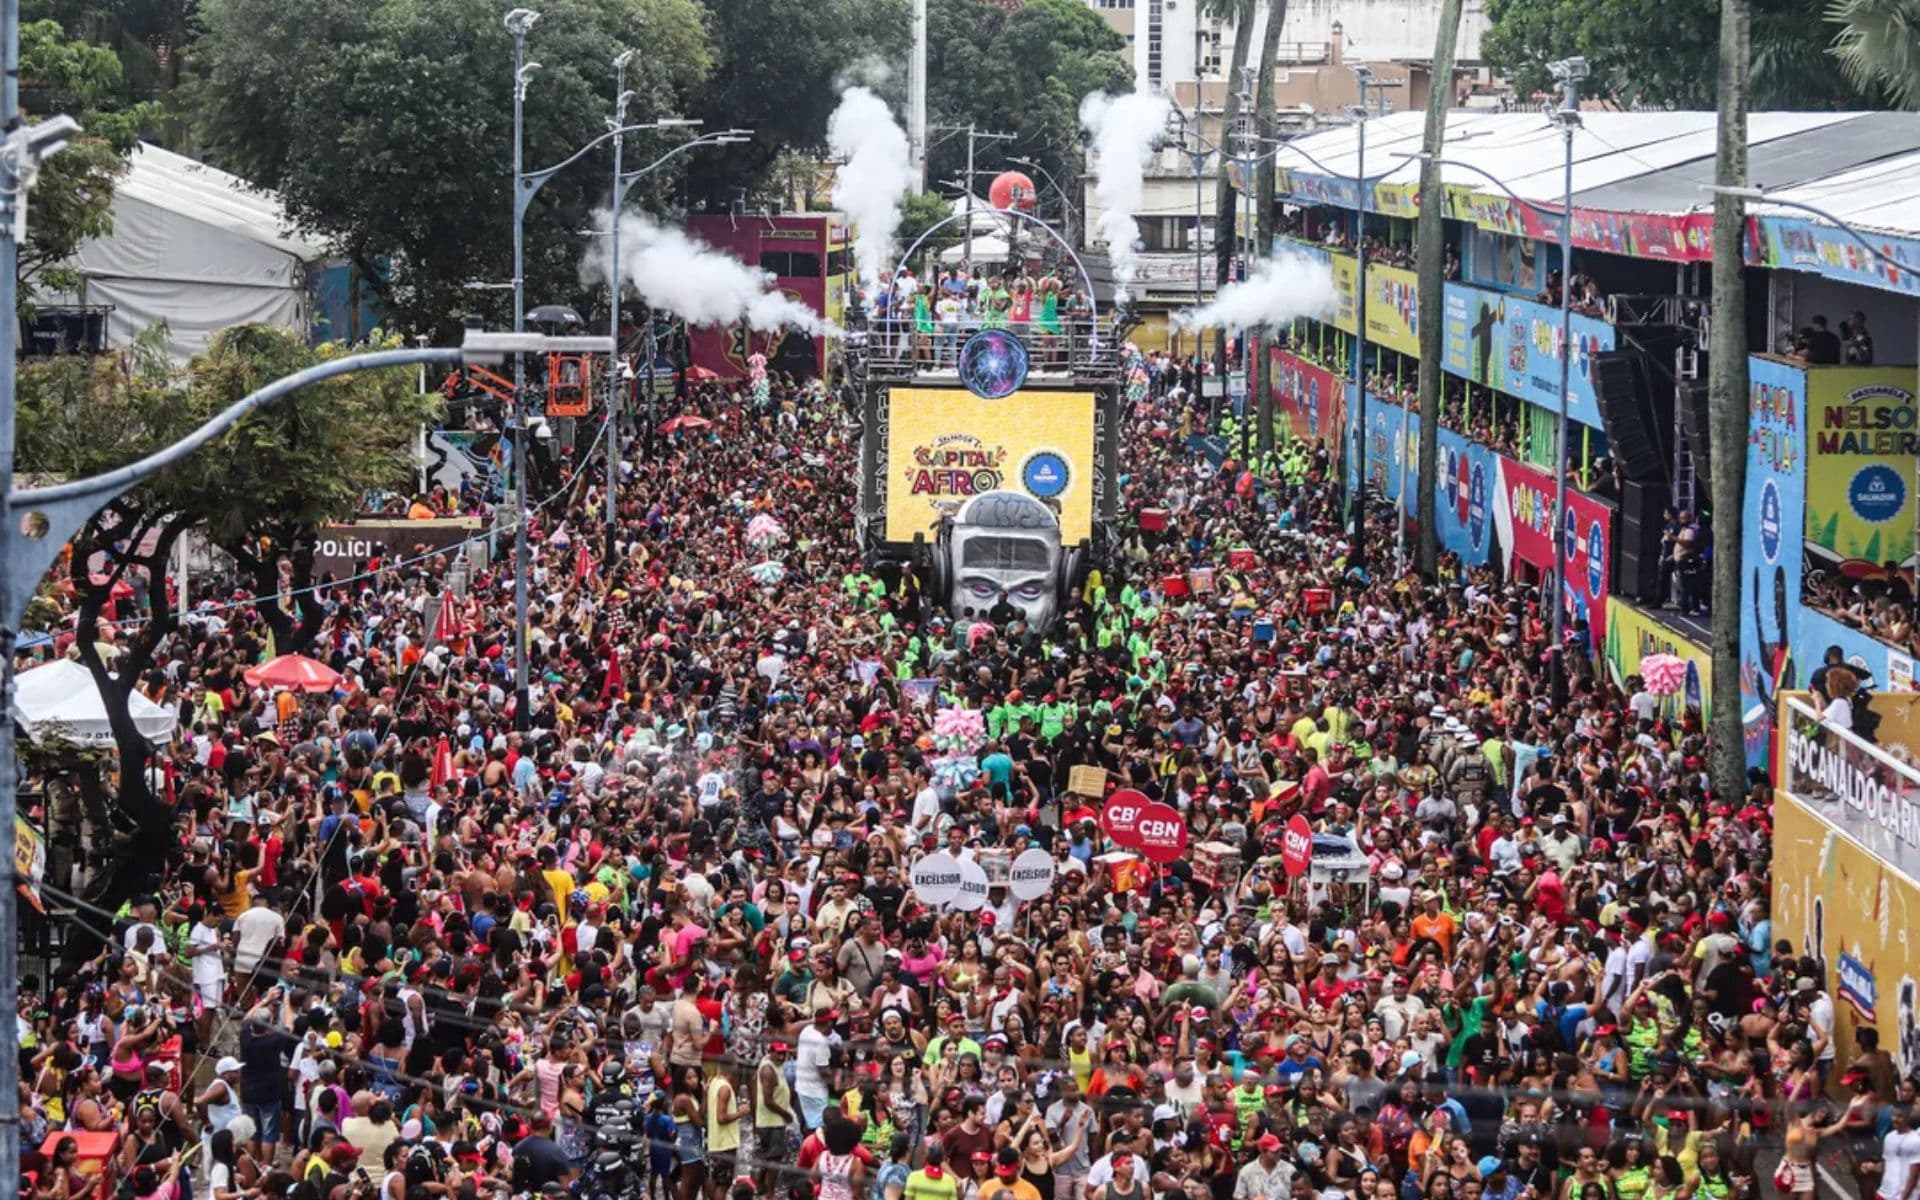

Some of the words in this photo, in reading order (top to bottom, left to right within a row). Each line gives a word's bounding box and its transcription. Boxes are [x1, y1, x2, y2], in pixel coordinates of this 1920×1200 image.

[1817, 431, 1920, 456] MALEIR
[914, 447, 999, 467] CAPITAL
[912, 467, 998, 495] AFRO
[1139, 819, 1180, 838] CBN
[1285, 829, 1309, 852] CBN
[915, 873, 960, 885] EXCELSIOR
[1013, 868, 1051, 880] EXCELSIOR
